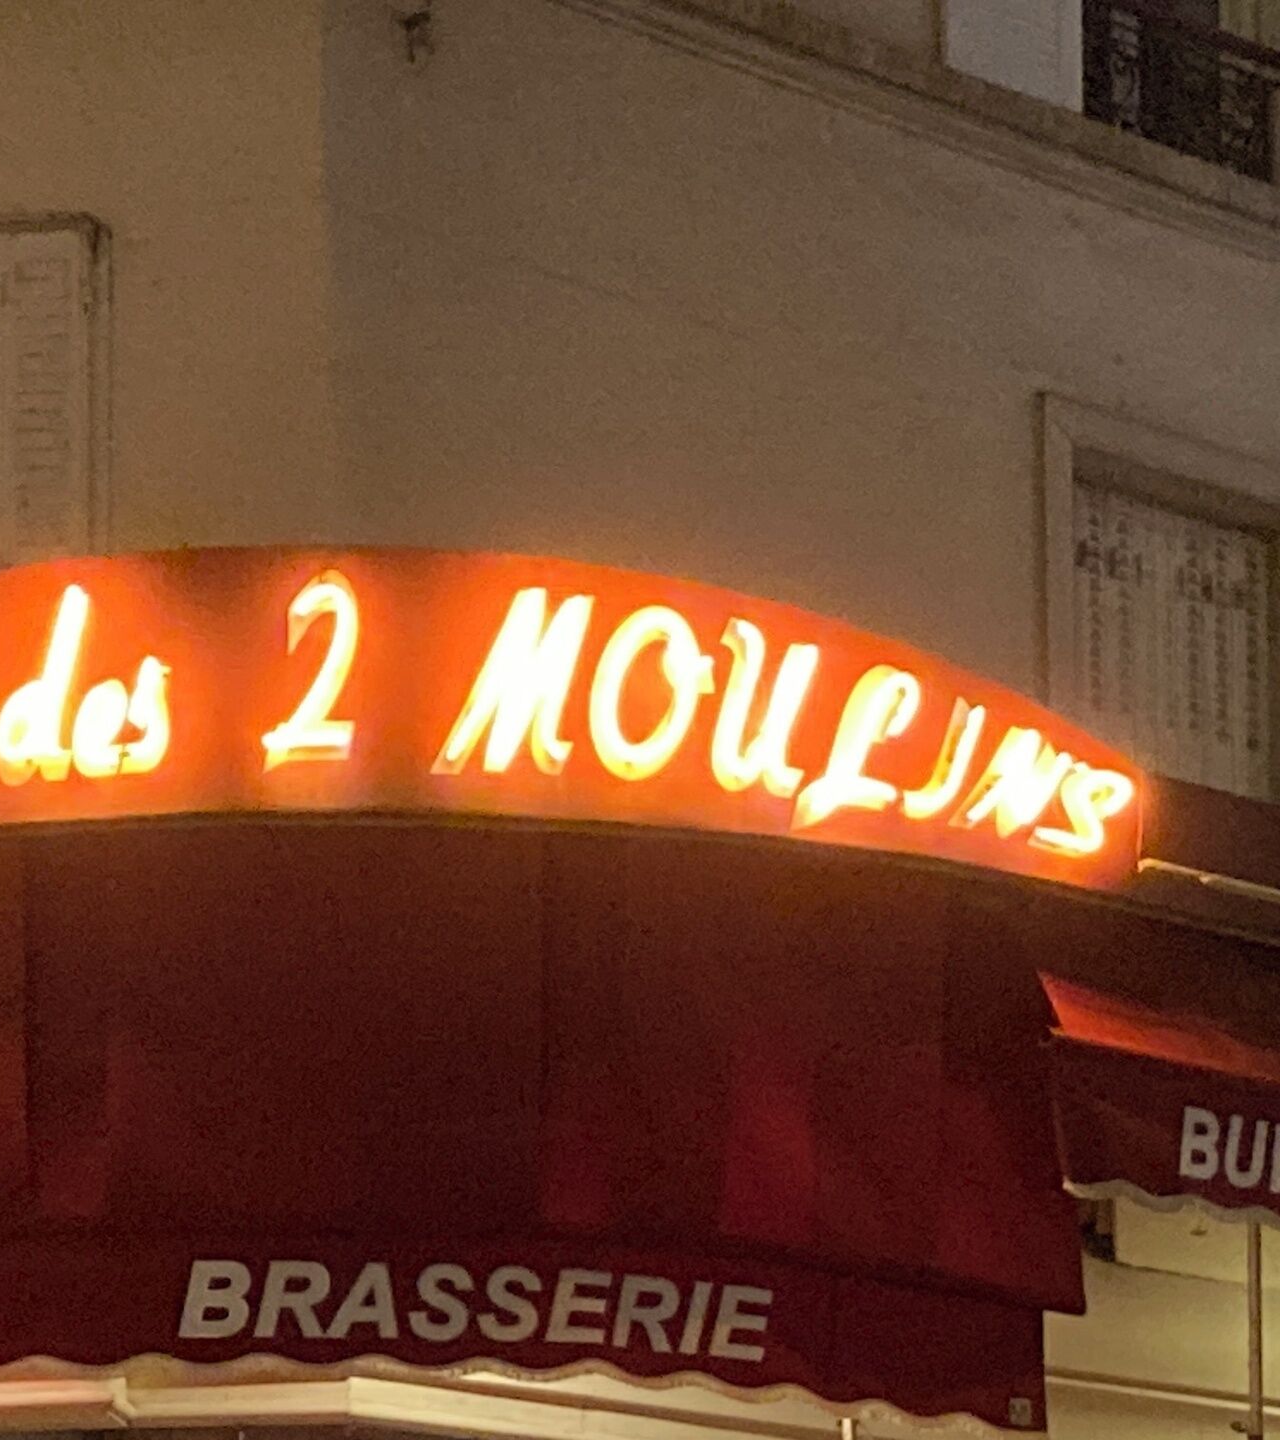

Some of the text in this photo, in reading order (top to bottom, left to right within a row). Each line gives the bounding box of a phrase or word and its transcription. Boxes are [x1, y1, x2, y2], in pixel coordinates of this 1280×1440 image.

[262, 569, 360, 774] 2
[430, 587, 1135, 857] MOULINS
[178, 1258, 774, 1363] BRASSERIE
